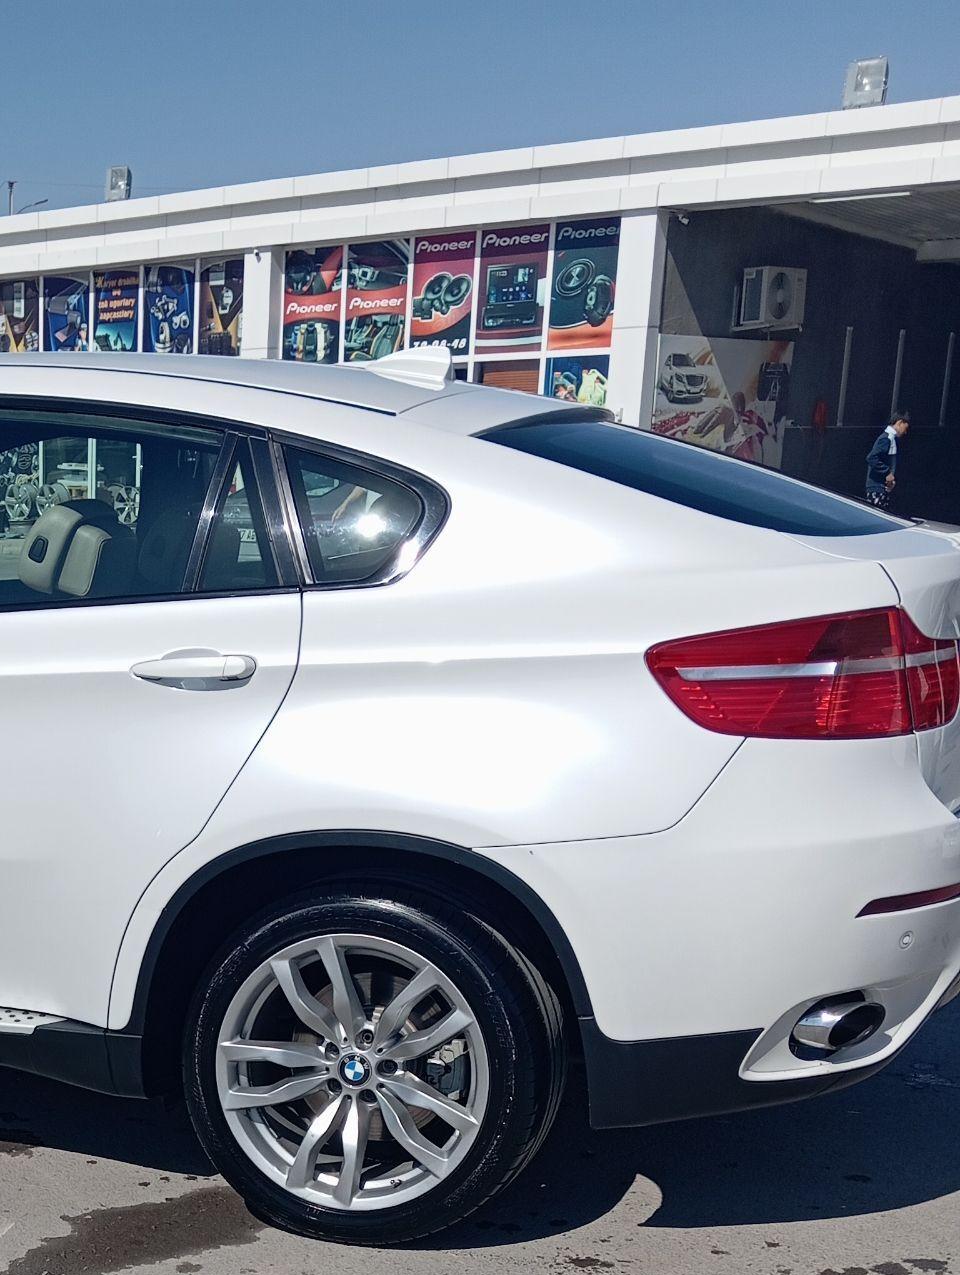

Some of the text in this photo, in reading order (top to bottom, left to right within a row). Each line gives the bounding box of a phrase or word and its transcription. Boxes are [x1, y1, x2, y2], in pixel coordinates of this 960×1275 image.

[482, 232, 549, 248] Pioneer
[415, 240, 474, 254] Pioneer
[286, 302, 338, 315] Pioneer
[349, 297, 404, 310] Pioneer
